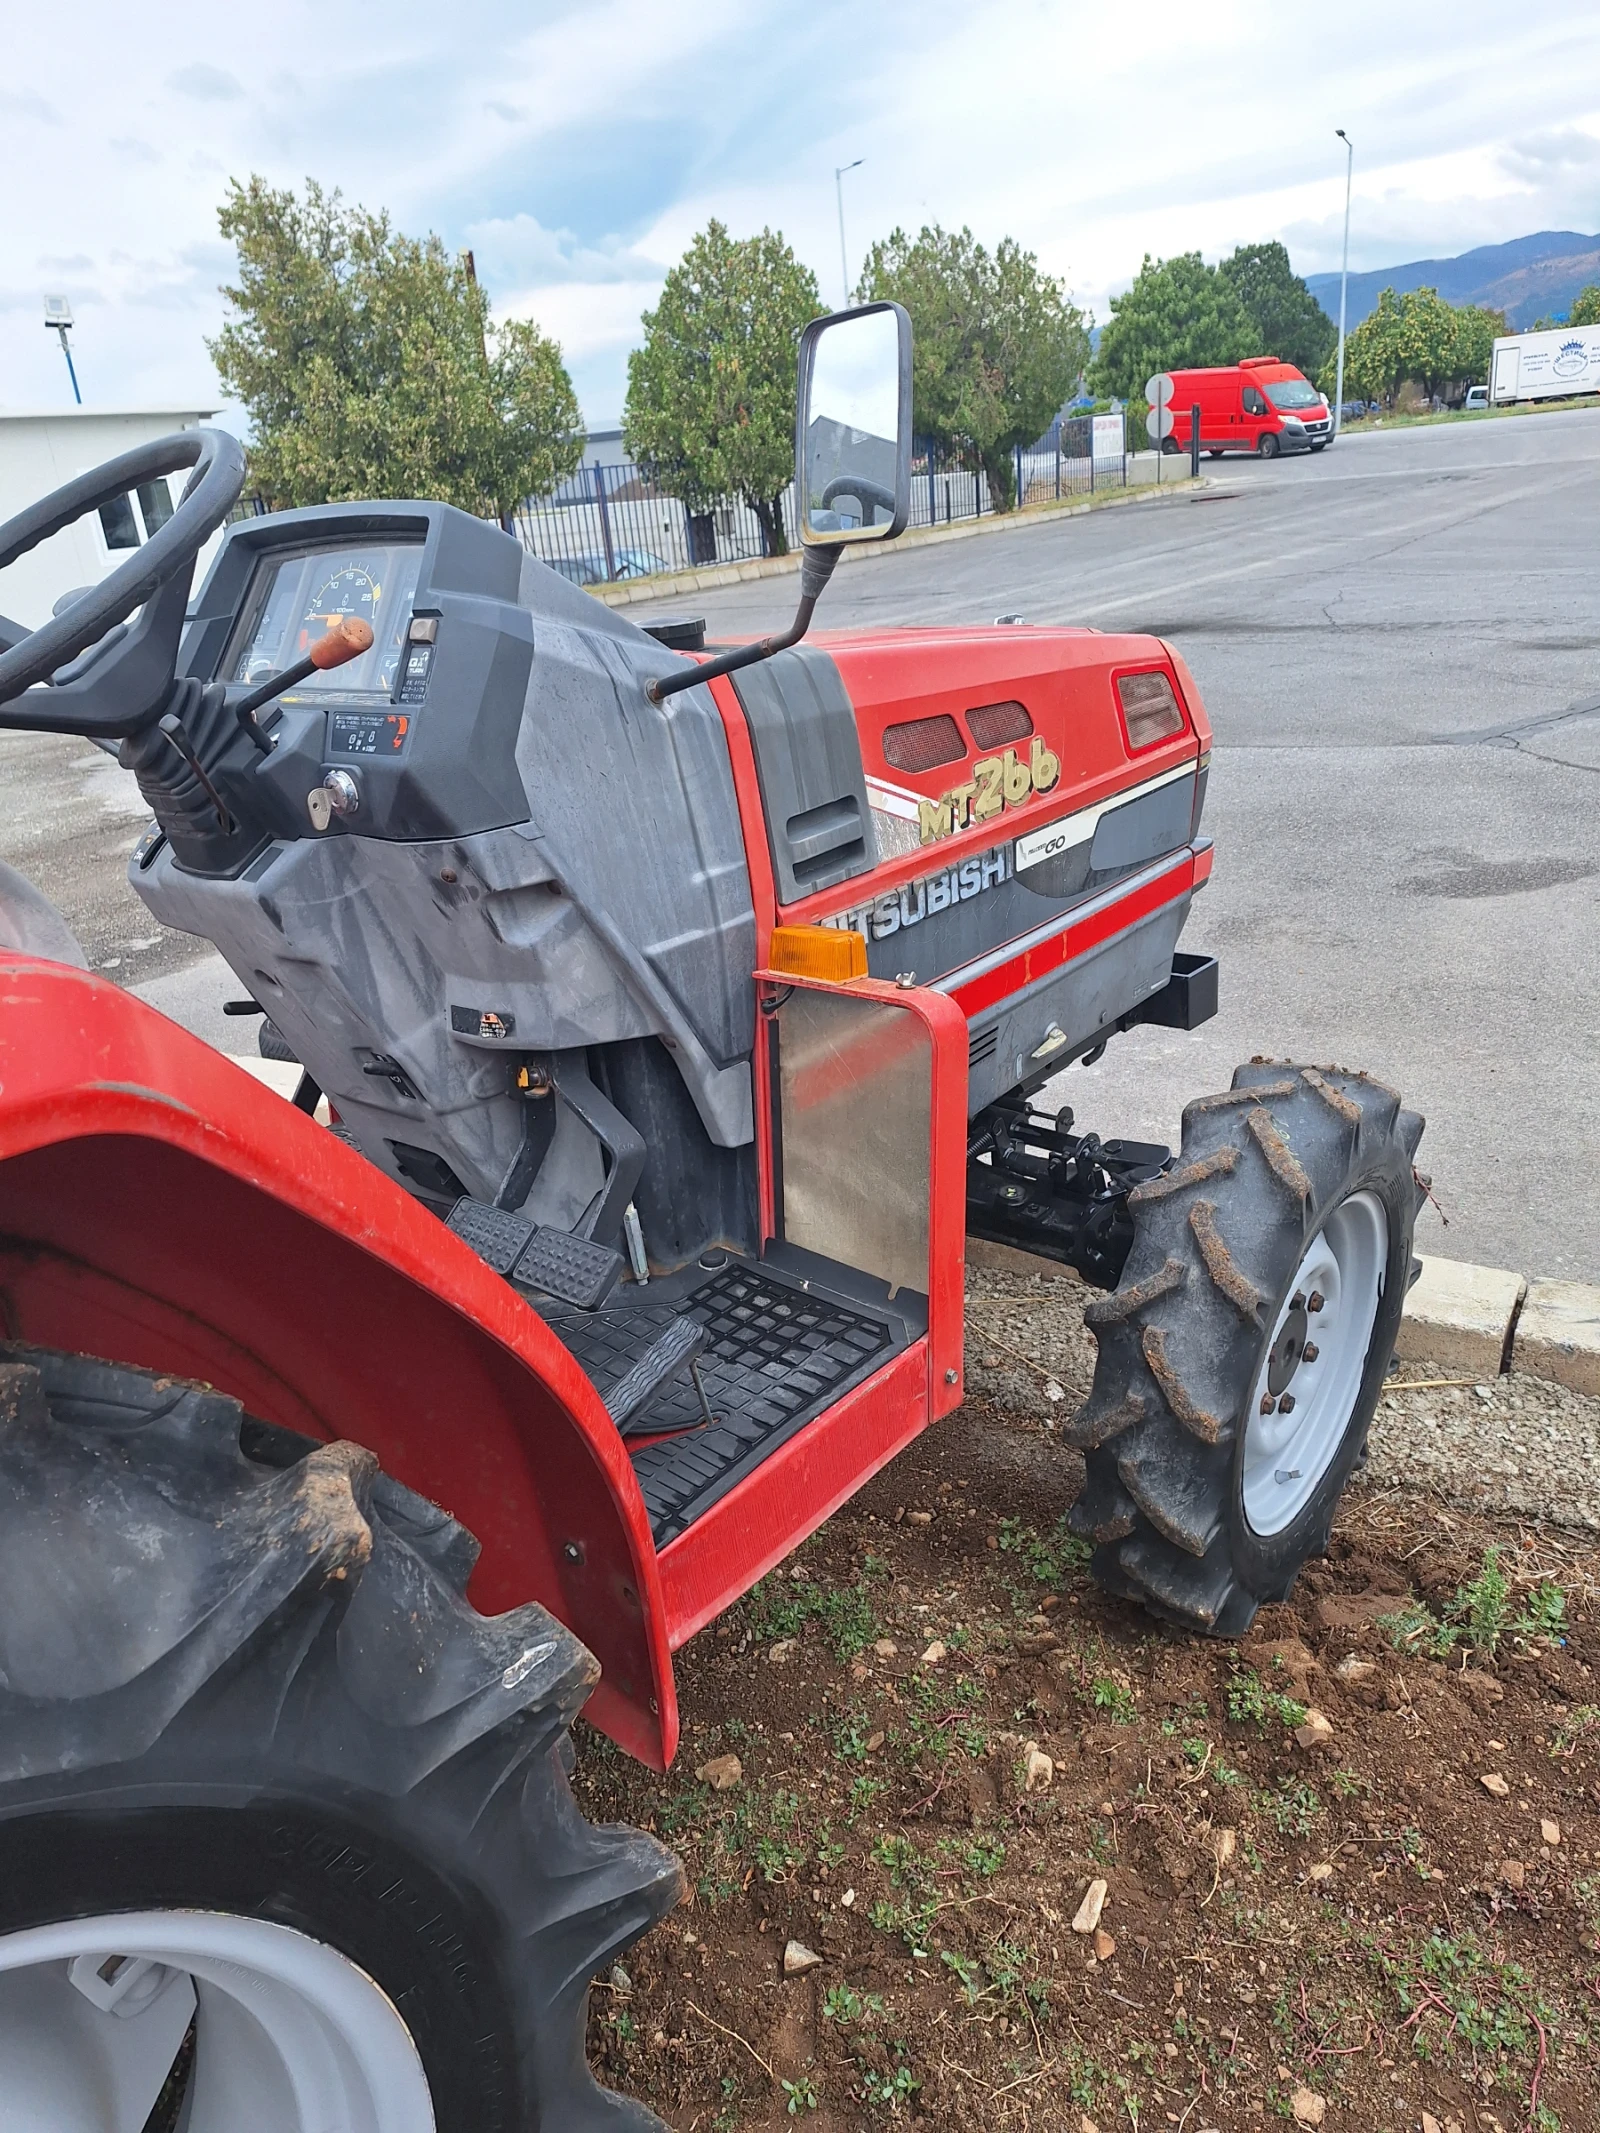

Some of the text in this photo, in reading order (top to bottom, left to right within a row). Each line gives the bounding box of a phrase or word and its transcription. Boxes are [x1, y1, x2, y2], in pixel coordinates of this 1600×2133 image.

[345, 572, 355, 580] 15
[330, 581, 340, 589] 10
[355, 578, 367, 586] 20
[361, 593, 372, 601] 25
[918, 735, 1061, 846] MT266
[1045, 835, 1066, 854] GO
[820, 838, 1014, 945] TSUBISHI
